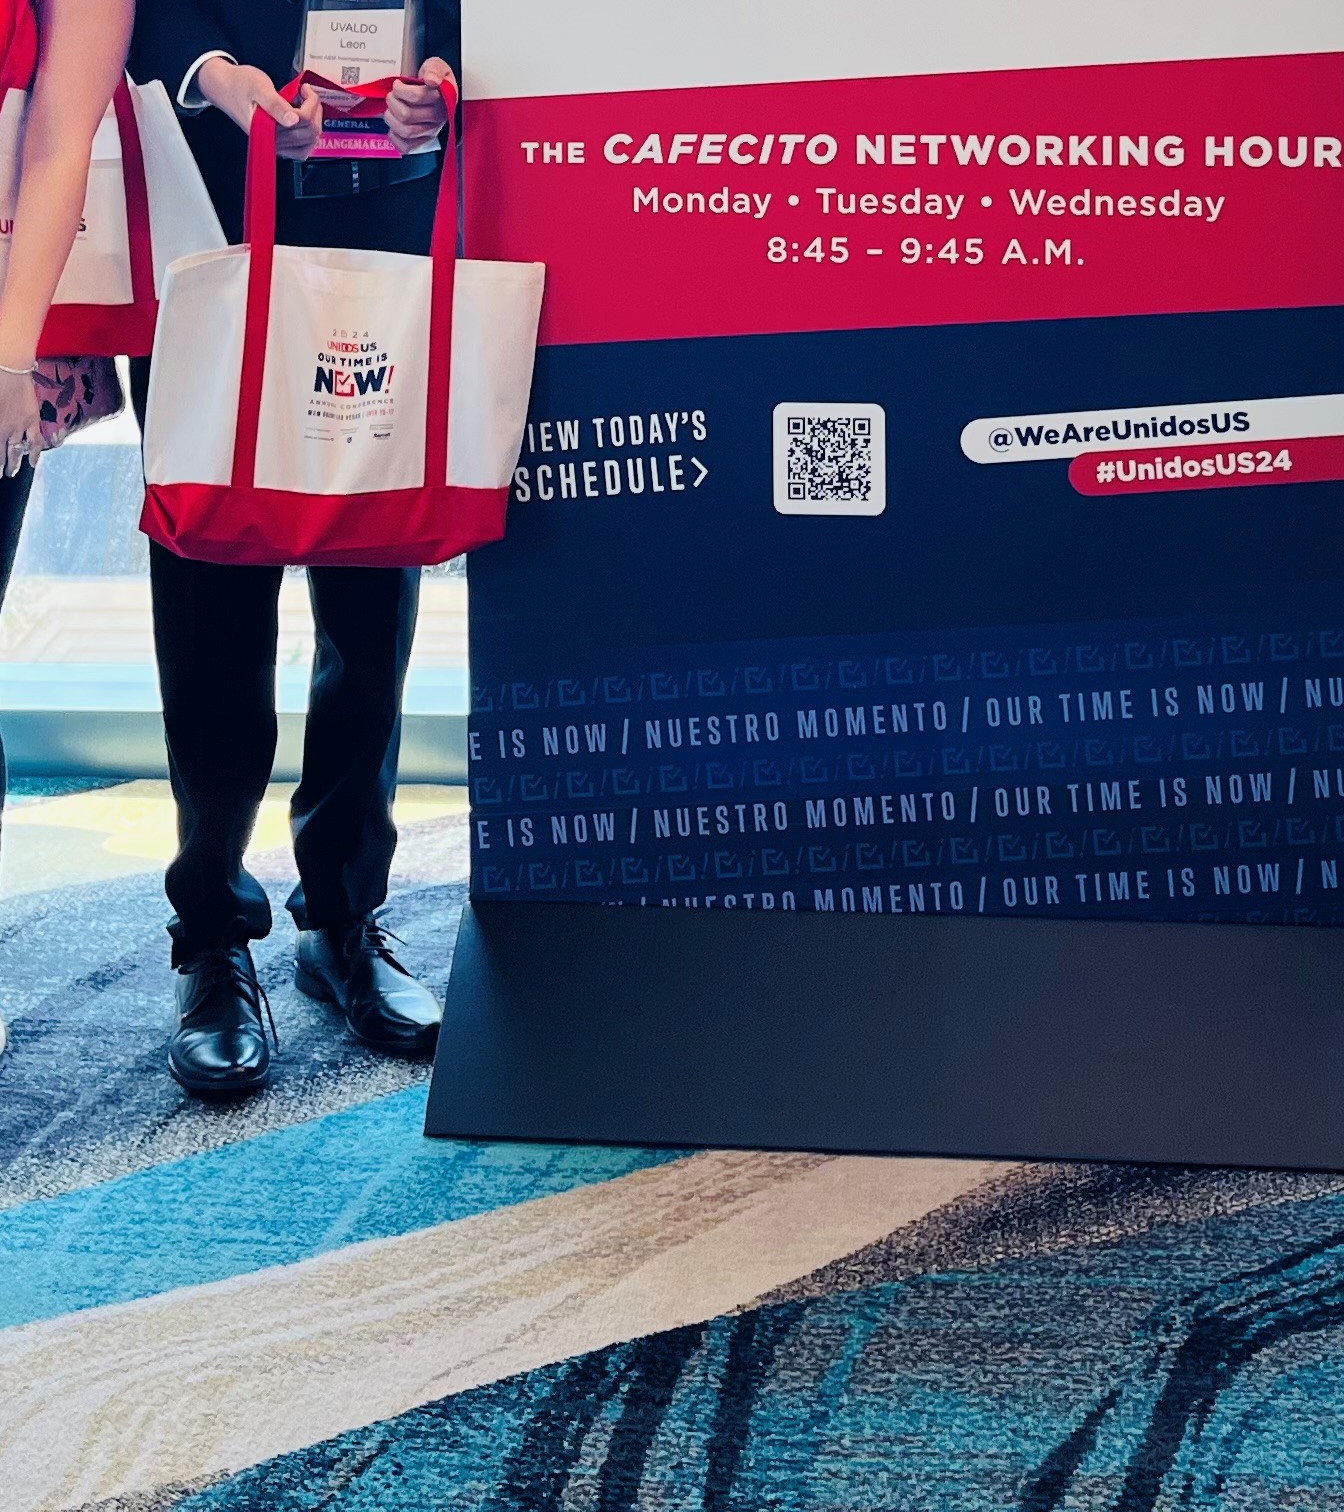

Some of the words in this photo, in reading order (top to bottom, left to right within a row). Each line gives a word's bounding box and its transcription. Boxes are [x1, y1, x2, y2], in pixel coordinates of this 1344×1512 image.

[330, 22, 378, 34] UVALDO
[340, 39, 366, 49] Leon
[324, 119, 371, 129] GENERAL
[317, 138, 396, 150] HANGEMAKERS
[521, 142, 584, 163] THE
[604, 134, 837, 164] CAFECITO
[857, 135, 1184, 166] NETWORKING
[1206, 136, 1341, 167] HOUR
[634, 187, 771, 218] Monday
[816, 188, 964, 219] Tuesday
[1009, 189, 1224, 222] Wednesday
[768, 237, 848, 263] 8:45
[901, 238, 983, 264] 9:45
[1002, 239, 1083, 265] A.M.
[317, 352, 337, 365] OUR
[339, 357, 373, 367] TIME
[376, 352, 388, 363] IS
[528, 420, 579, 452] IEW
[592, 410, 706, 447] TODAY’S
[988, 412, 1250, 452] @WeAreUnidosUS
[1096, 449, 1292, 484] #UnidosUS24
[499, 729, 525, 758] IS
[543, 724, 605, 755] NOW
[646, 712, 778, 748] NUESTRO
[797, 702, 946, 738] MOMENTO
[987, 696, 1043, 726] OUR
[1059, 690, 1133, 722] TIME
[1151, 687, 1178, 716] IS
[1197, 682, 1263, 714] NOW
[507, 818, 533, 847] IS
[551, 813, 614, 844] NOW
[654, 802, 787, 838] NUESTRO
[806, 792, 954, 828] MOMENTO
[995, 786, 1051, 816] OUR
[1067, 780, 1141, 812] TIME
[1160, 778, 1187, 807] IS
[1206, 773, 1271, 804] NOW
[814, 881, 963, 912] MOMENTO
[1003, 876, 1059, 907] OUR
[1076, 871, 1149, 902] TIME
[1168, 868, 1194, 897] IS
[1214, 864, 1279, 894] NOW
